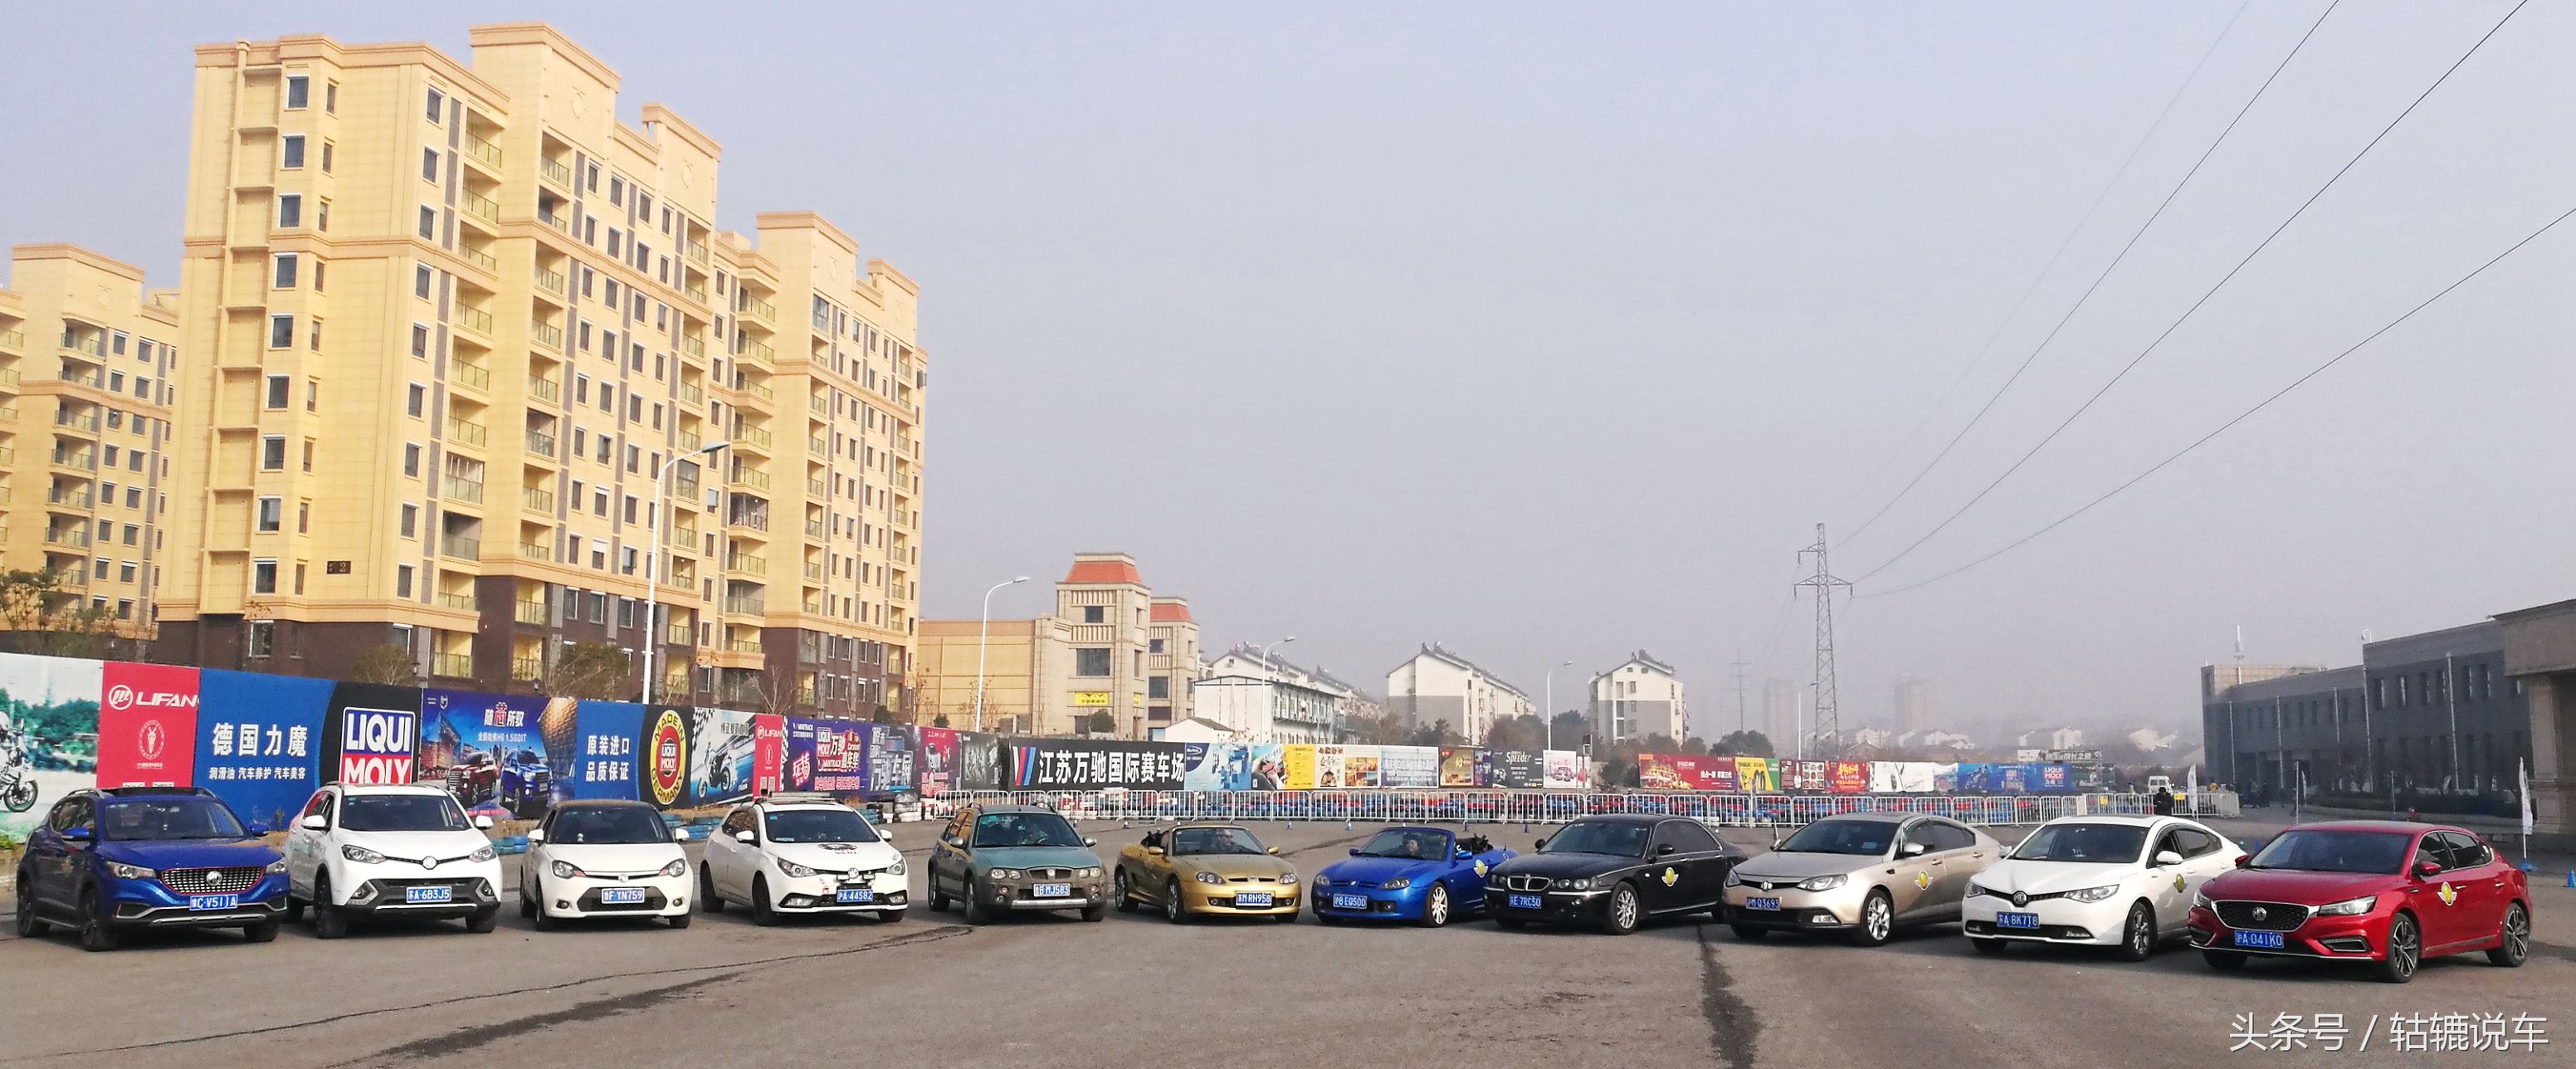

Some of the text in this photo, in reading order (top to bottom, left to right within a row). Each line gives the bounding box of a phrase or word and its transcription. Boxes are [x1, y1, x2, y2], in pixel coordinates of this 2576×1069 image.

[212, 722, 308, 757] 德国力魔
[346, 713, 411, 753] LIQUI
[654, 713, 679, 742] MADE
[587, 735, 630, 756] 原装进口
[661, 745, 676, 757] LIQUI
[209, 767, 306, 780] 润滑油 汽车养护 汽车美容
[343, 755, 412, 784] MOLY
[585, 760, 629, 783] 品质保证
[661, 757, 676, 769] MOLY
[1037, 750, 1185, 785] 江苏万驰国际赛车场
[651, 768, 683, 803] GERMANY
